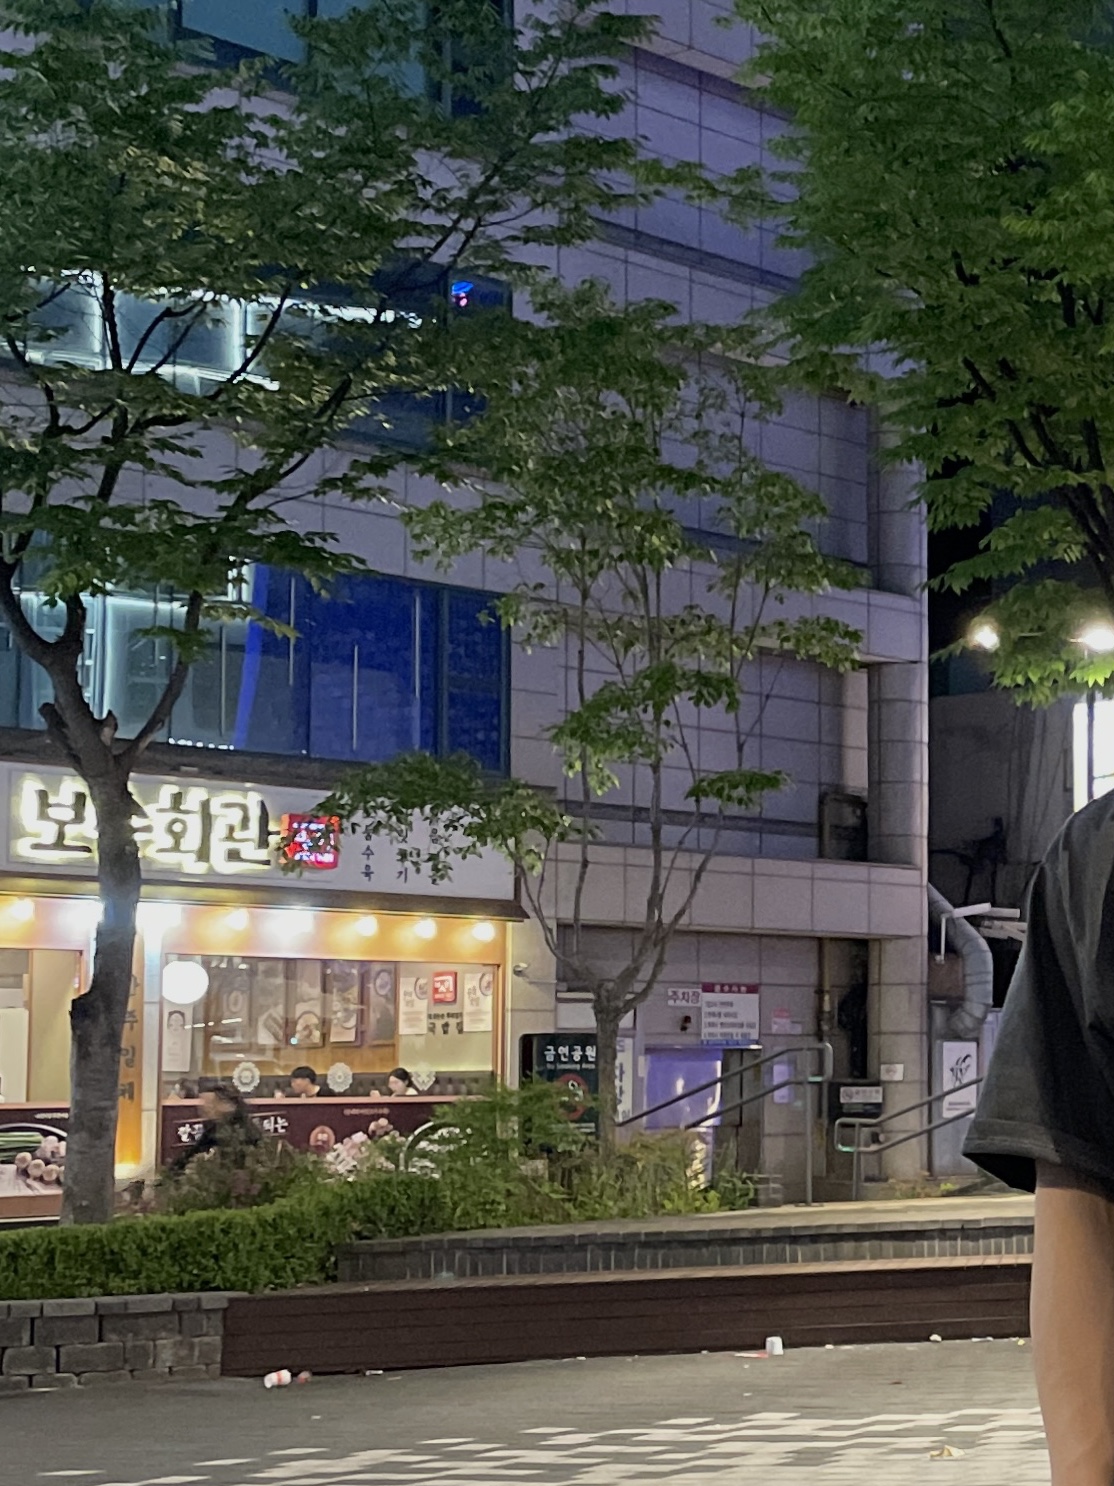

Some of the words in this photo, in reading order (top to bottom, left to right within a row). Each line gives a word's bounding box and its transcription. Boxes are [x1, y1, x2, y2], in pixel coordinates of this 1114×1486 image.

[28, 788, 273, 864] 보회관
[668, 989, 700, 1005] 주차장
[544, 1045, 597, 1062] 금연공원
